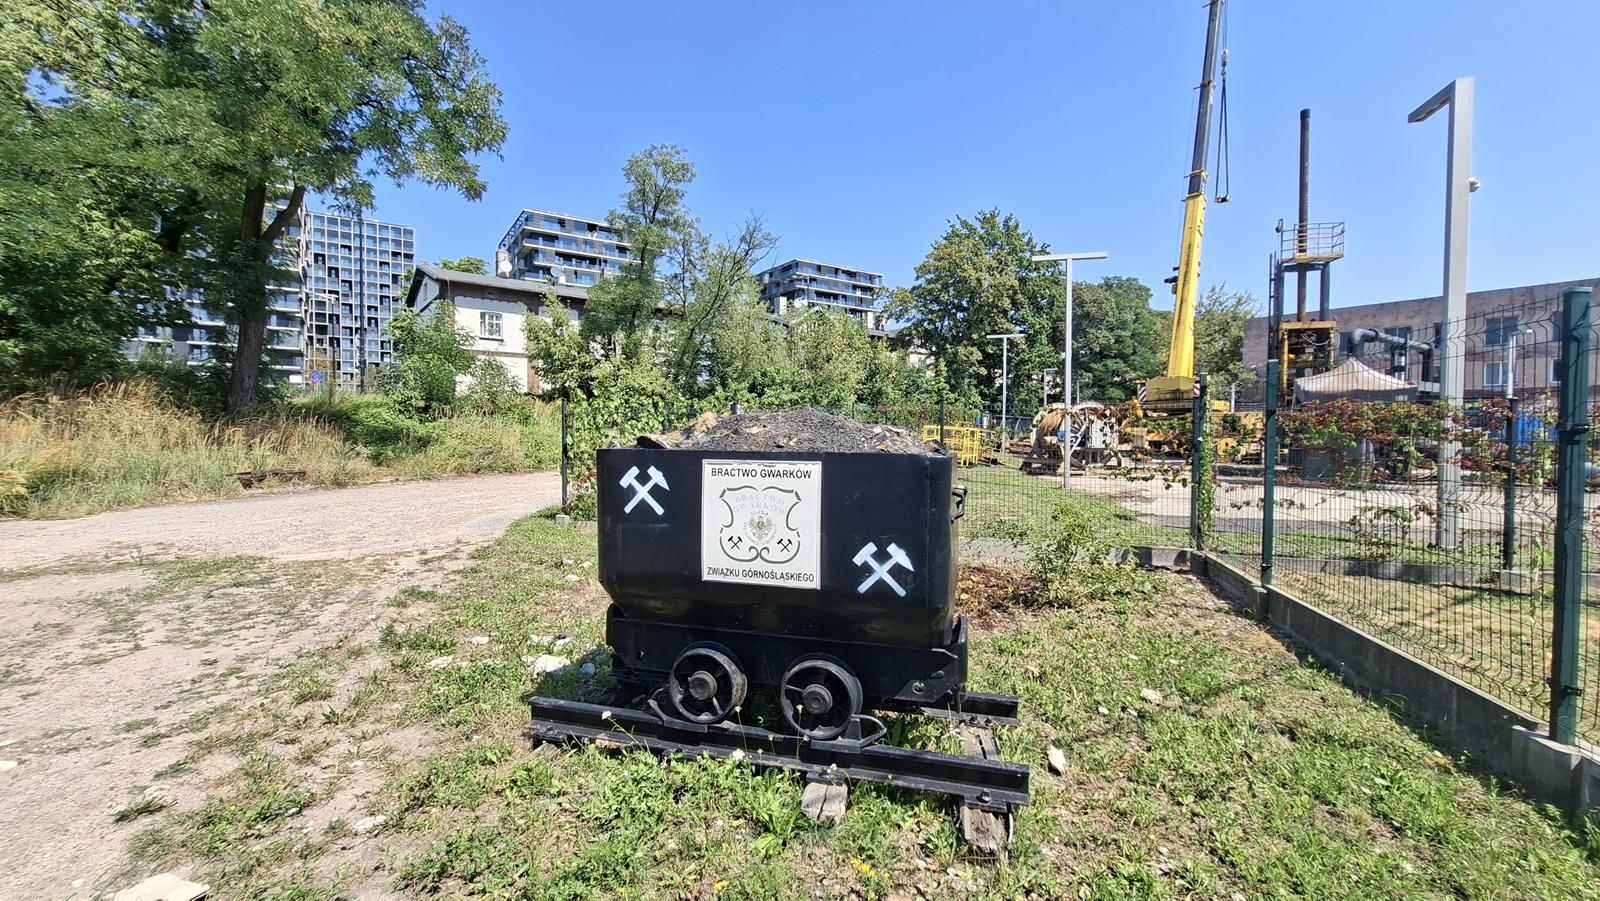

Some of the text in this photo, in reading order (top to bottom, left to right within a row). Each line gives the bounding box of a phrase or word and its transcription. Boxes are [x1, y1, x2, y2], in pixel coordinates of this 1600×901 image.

[711, 467, 812, 479] BRACTWO GWARKÓW
[707, 567, 814, 582] ZWIĄZKU GÓRNOŚLĄSKIEGO
